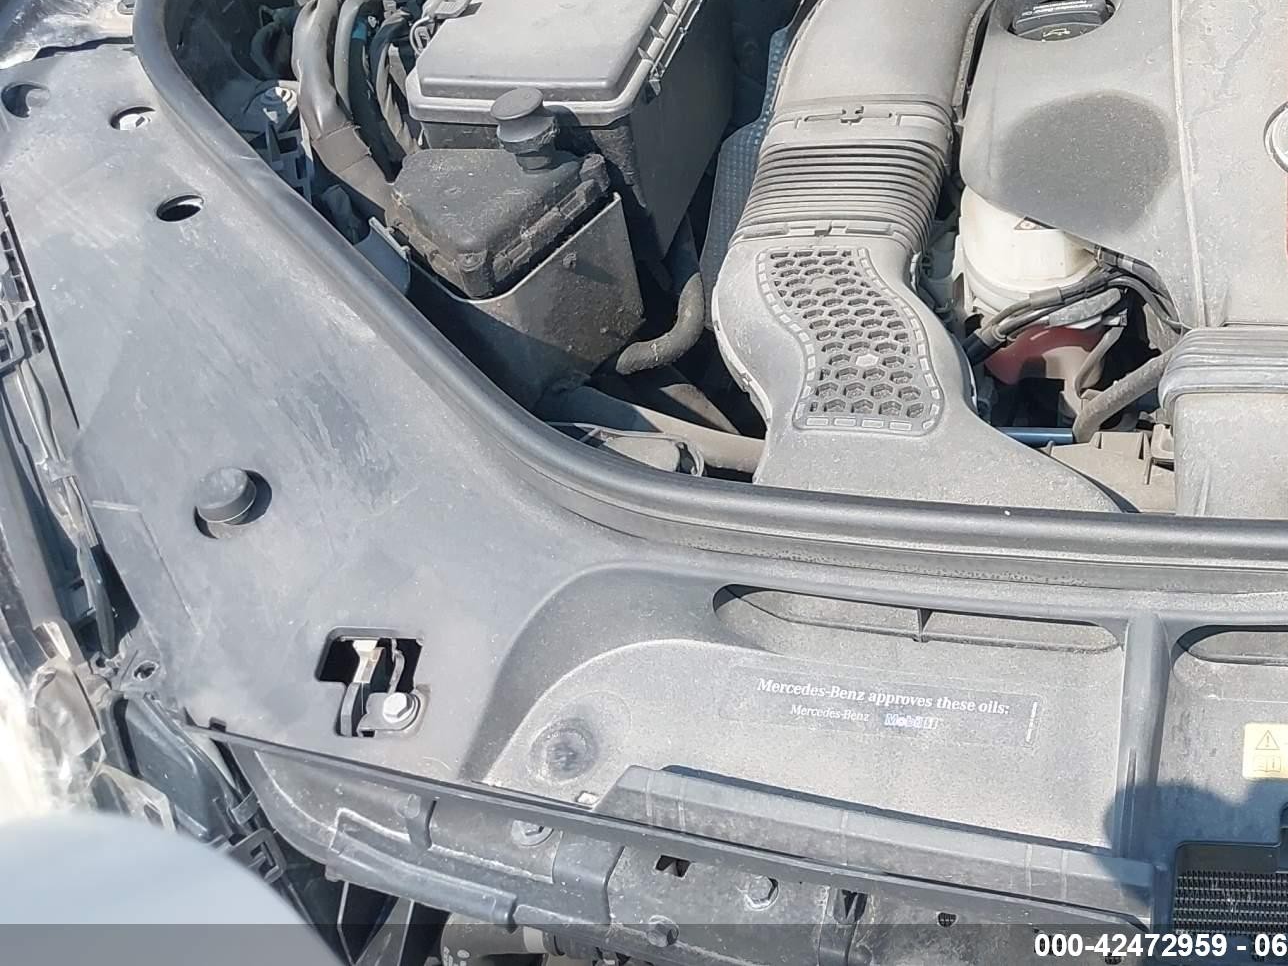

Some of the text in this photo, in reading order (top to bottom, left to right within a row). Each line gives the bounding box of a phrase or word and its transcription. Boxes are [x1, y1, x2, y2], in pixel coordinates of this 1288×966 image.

[757, 677, 1010, 715] Mercedes-Benz approves these oils:
[790, 704, 871, 722] Mercedes-Benz
